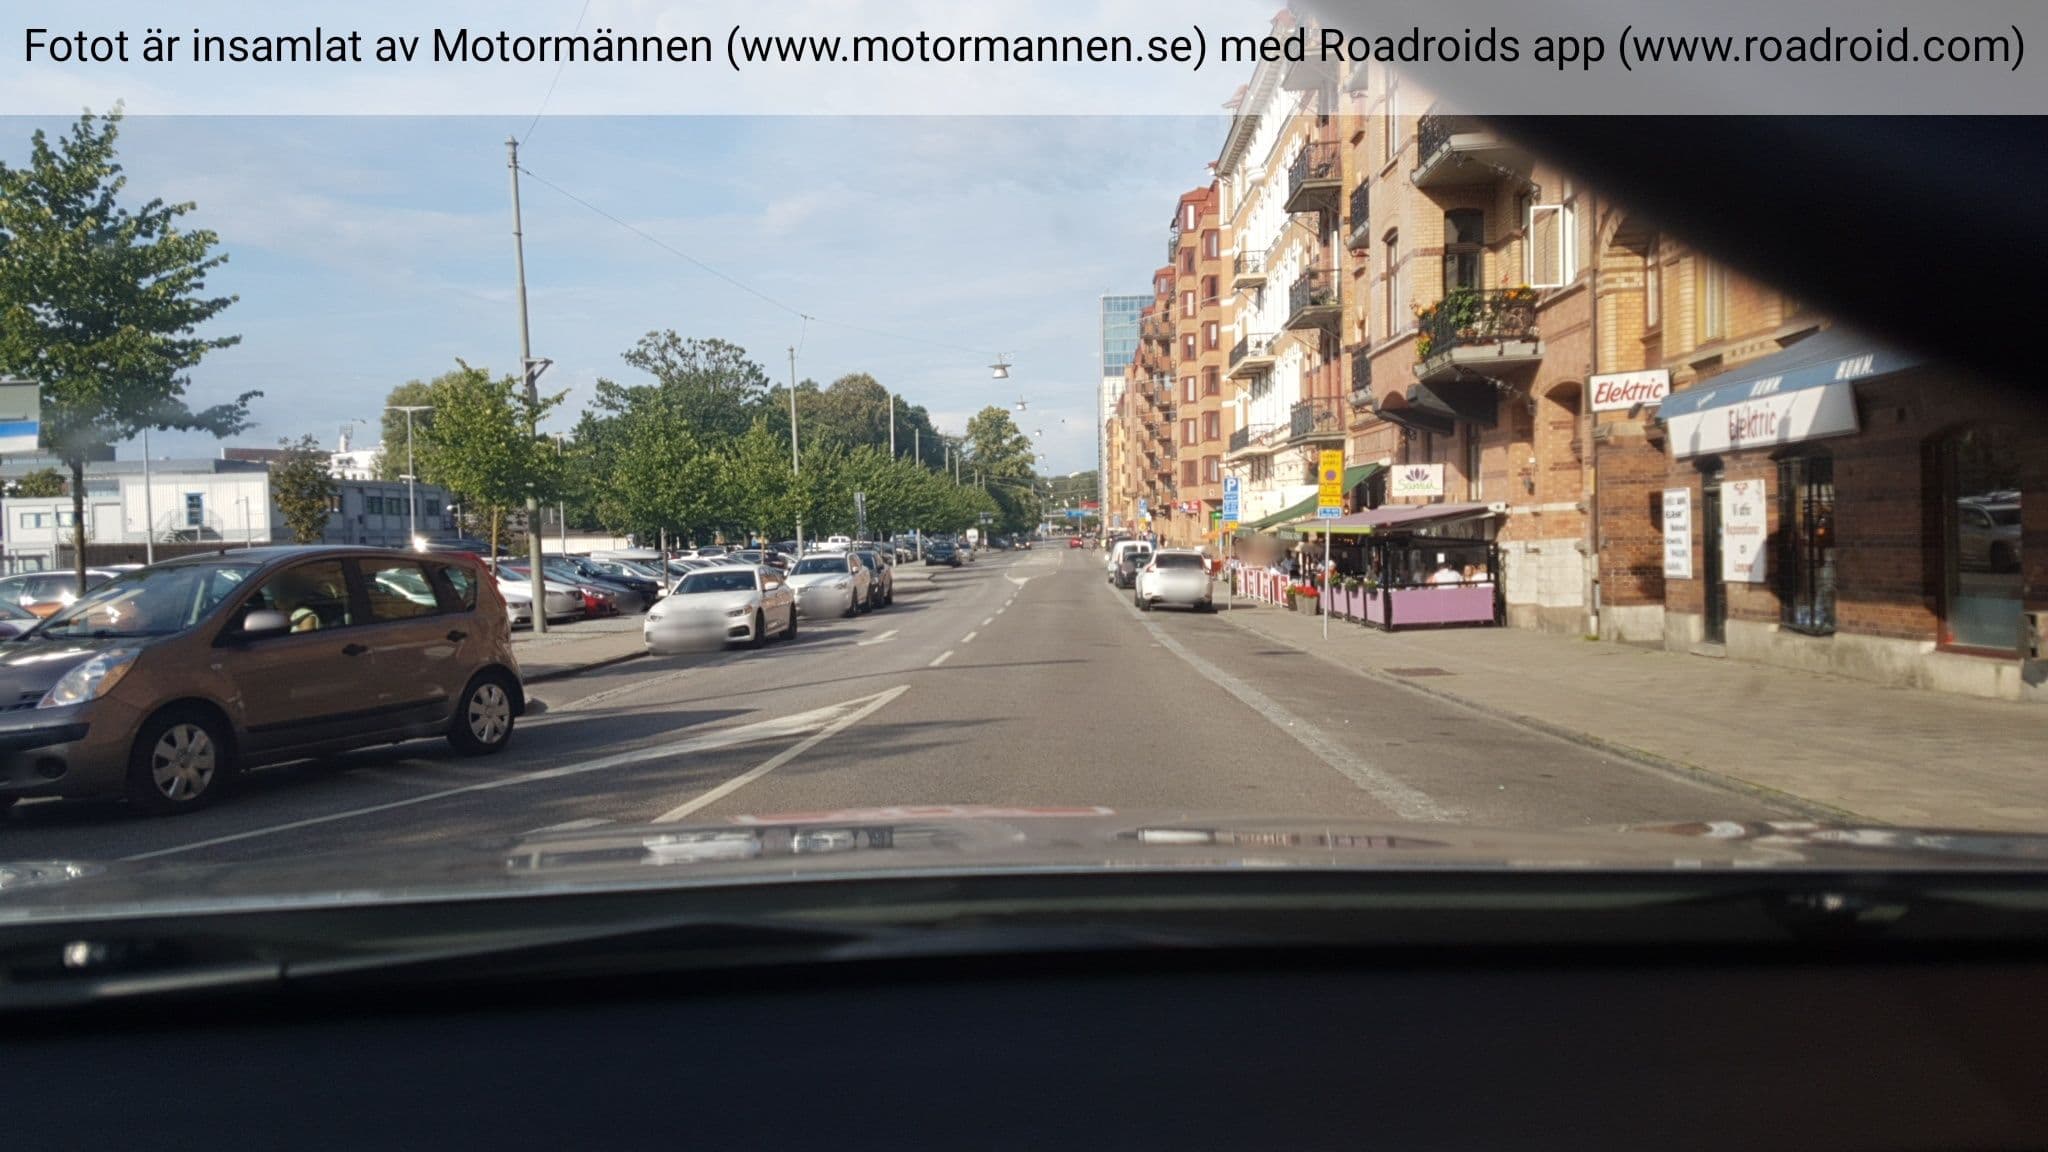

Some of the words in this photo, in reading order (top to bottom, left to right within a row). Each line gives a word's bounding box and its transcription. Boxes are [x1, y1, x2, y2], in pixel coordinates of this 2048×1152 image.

[1594, 378, 1664, 404] Elektric
[1728, 401, 1777, 441] Elektric
[1227, 479, 1236, 492] P
